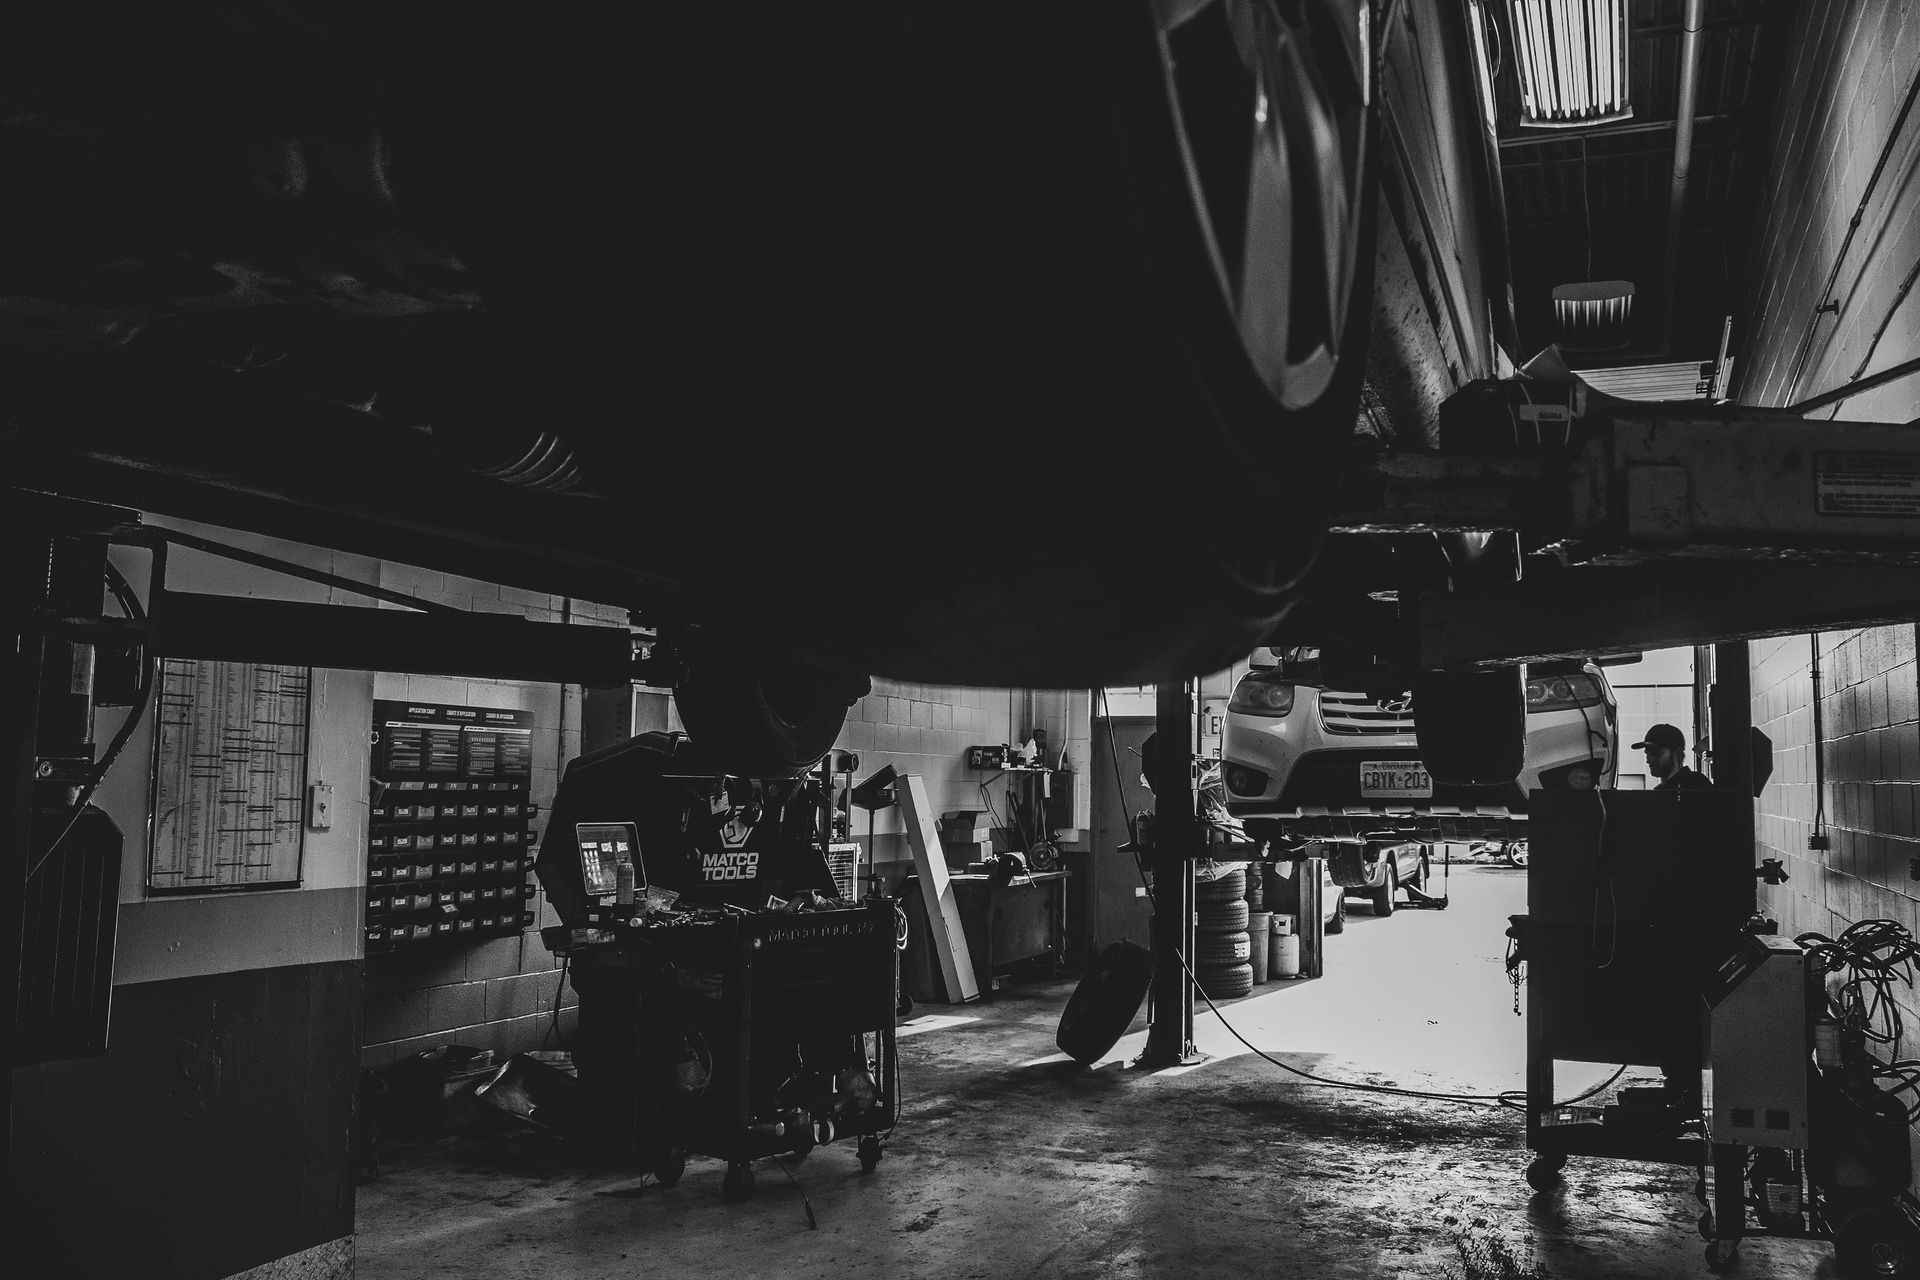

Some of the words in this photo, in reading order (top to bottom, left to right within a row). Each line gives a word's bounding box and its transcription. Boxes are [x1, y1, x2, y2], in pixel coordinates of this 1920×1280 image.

[1364, 771, 1396, 789] CBYK
[1404, 771, 1429, 789] 203
[702, 852, 759, 867] MATCO
[702, 865, 758, 881] TOOLS
